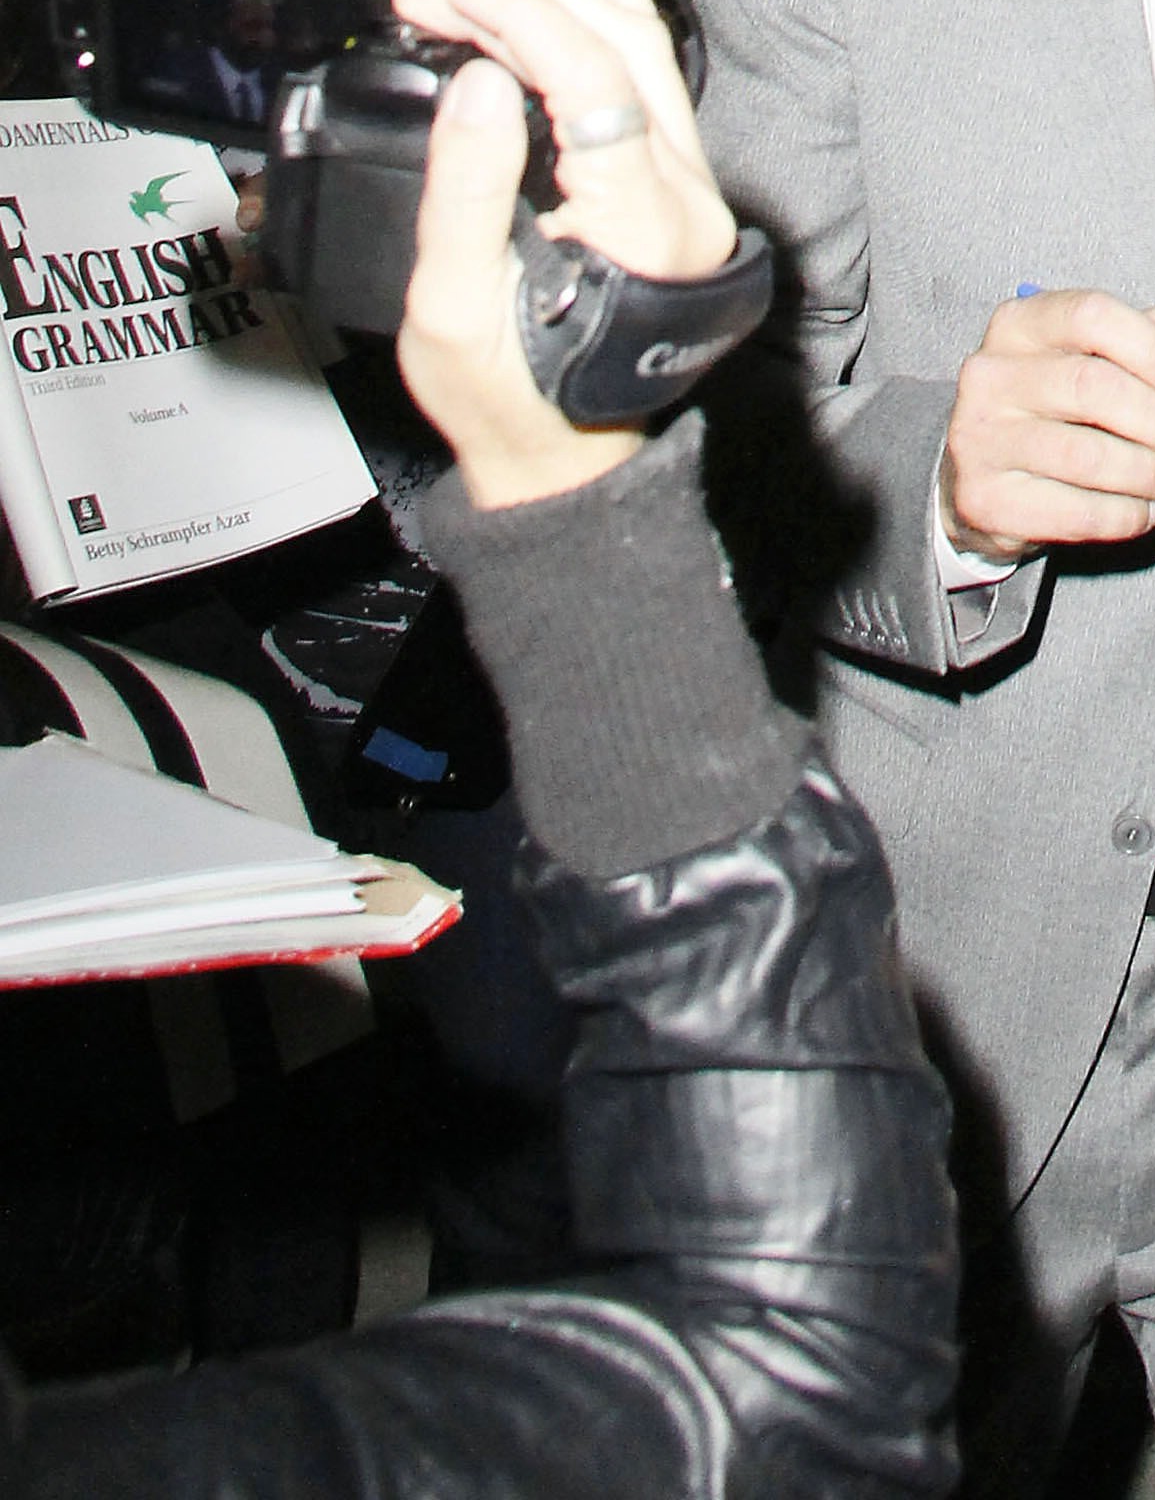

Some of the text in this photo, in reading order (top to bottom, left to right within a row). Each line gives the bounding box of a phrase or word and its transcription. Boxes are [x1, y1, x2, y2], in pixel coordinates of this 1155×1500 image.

[12, 290, 262, 373] GRAMMAR
[29, 374, 106, 396] Third Edition
[129, 401, 189, 424] Volume A
[84, 541, 126, 561] Betty
[126, 520, 213, 550] Schrampfer
[214, 510, 251, 531] Azar
